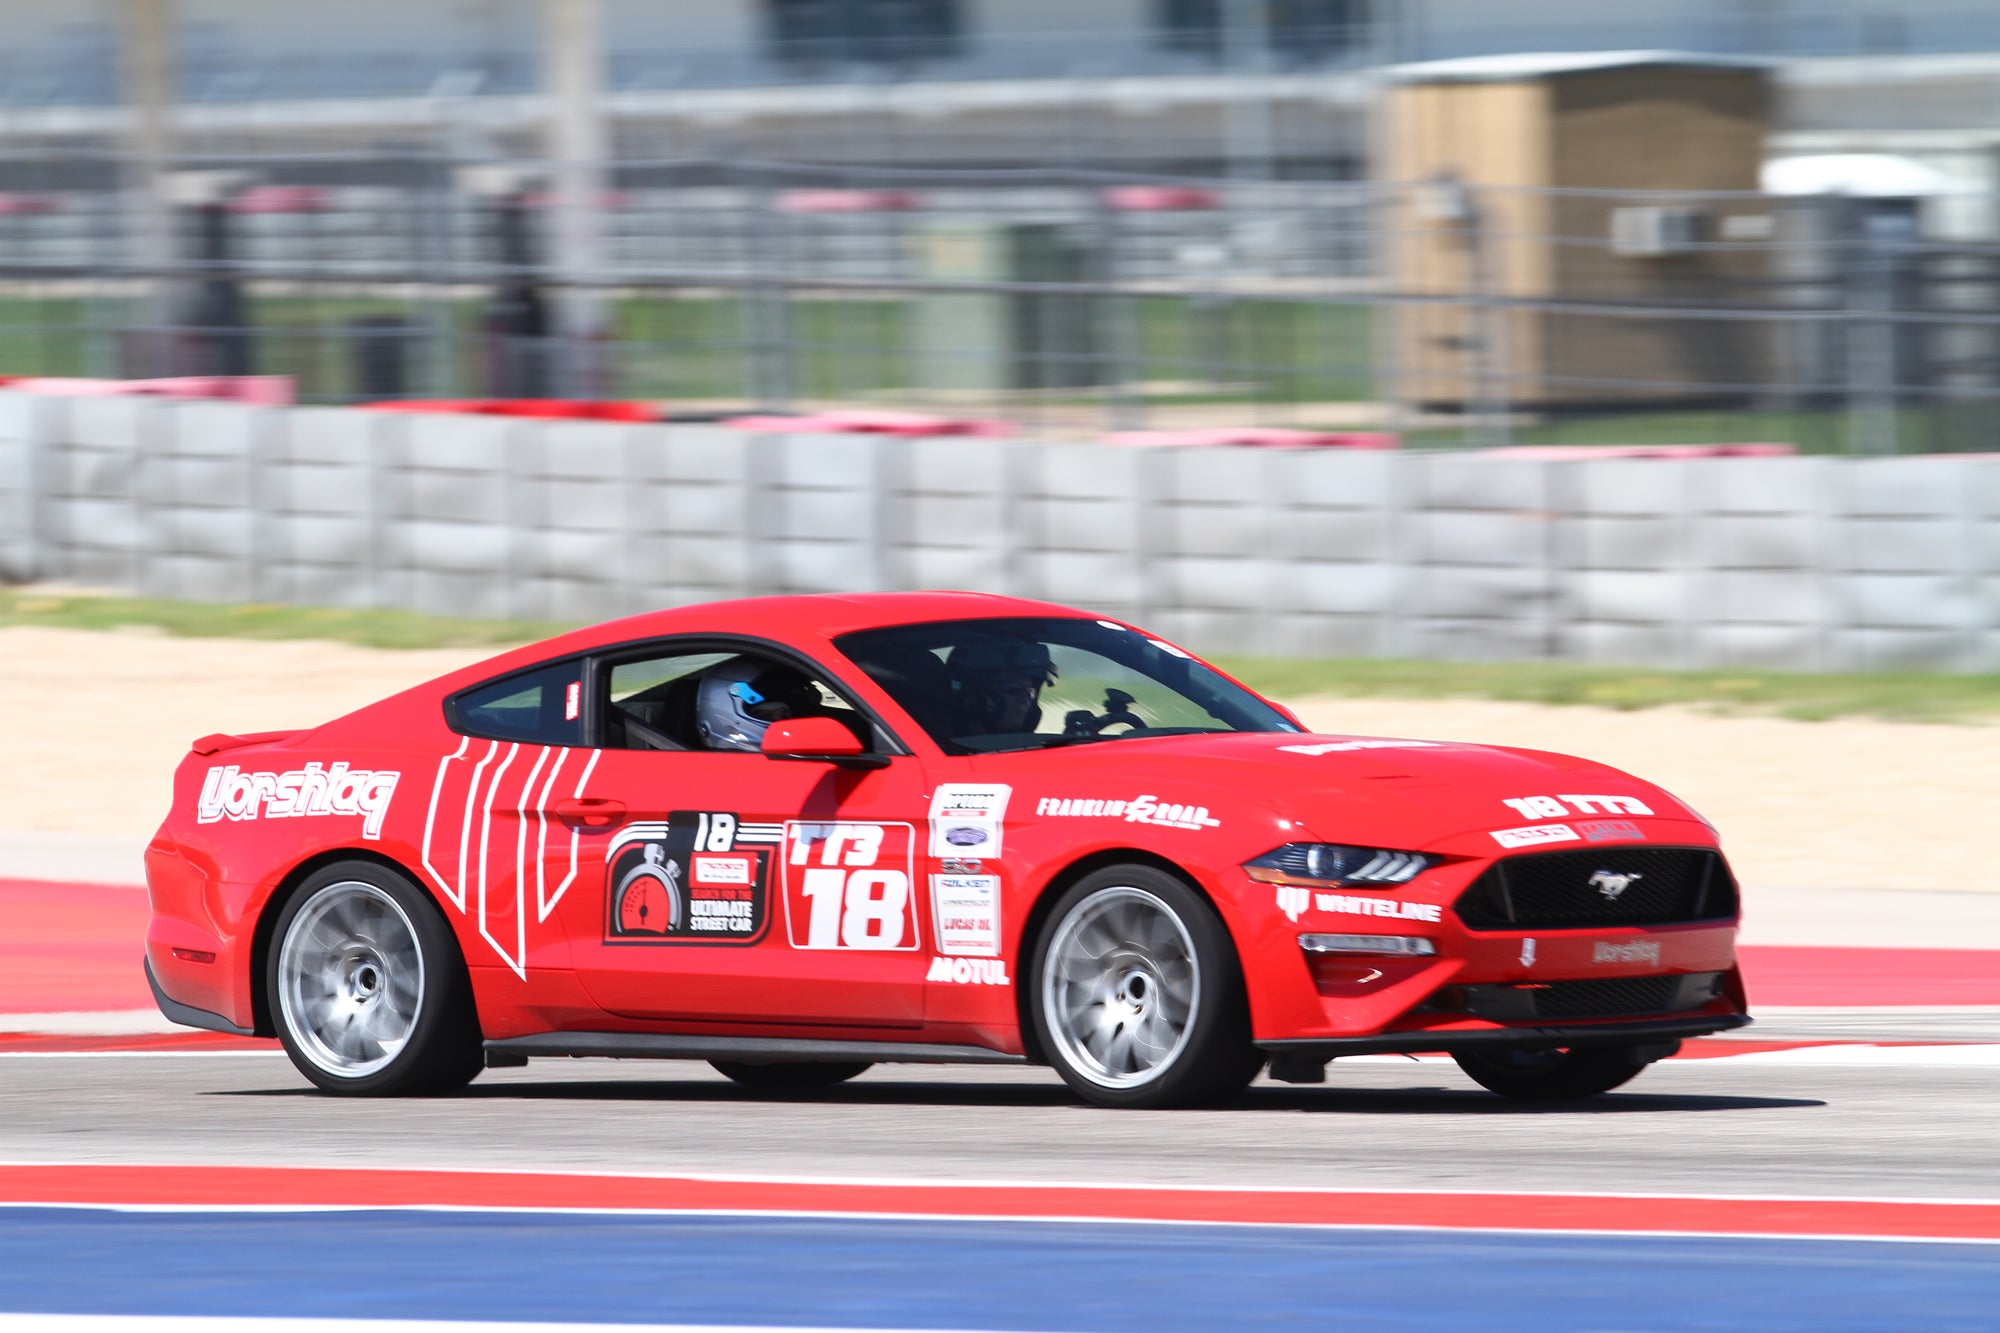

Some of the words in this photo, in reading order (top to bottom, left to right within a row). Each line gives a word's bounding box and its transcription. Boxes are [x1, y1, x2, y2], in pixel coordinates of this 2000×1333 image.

[1036, 797, 1127, 817] FRANKLIN
[1153, 803, 1210, 824] ROAD
[1502, 796, 1569, 820] 18
[1556, 795, 1655, 816] TT3
[693, 813, 736, 852] 18
[789, 824, 885, 866] TT3
[690, 900, 753, 917] ULTIMATE
[802, 868, 909, 948] 18
[1315, 893, 1443, 923] WHITELINE
[690, 916, 728, 931] STREET
[728, 917, 753, 931] CAR
[926, 956, 1010, 985] MOTUL
